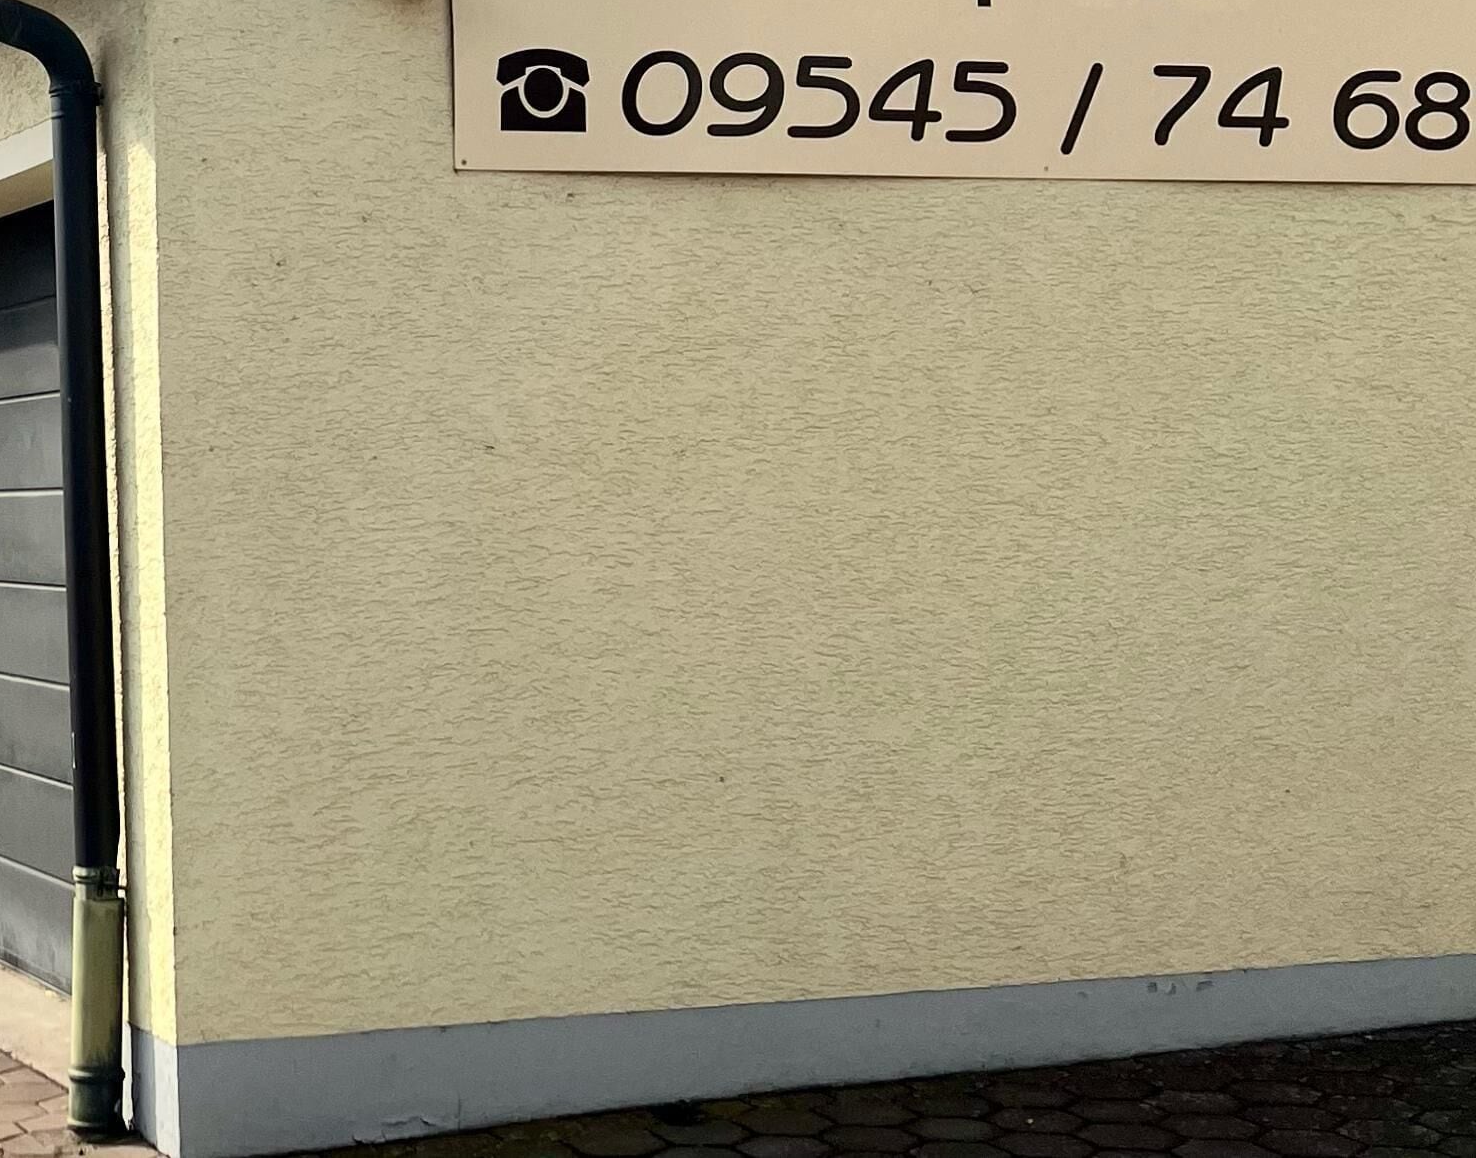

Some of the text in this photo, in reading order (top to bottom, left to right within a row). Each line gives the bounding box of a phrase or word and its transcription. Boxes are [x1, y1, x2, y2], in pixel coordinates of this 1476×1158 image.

[621, 50, 1471, 155] 09545 / 74 68
